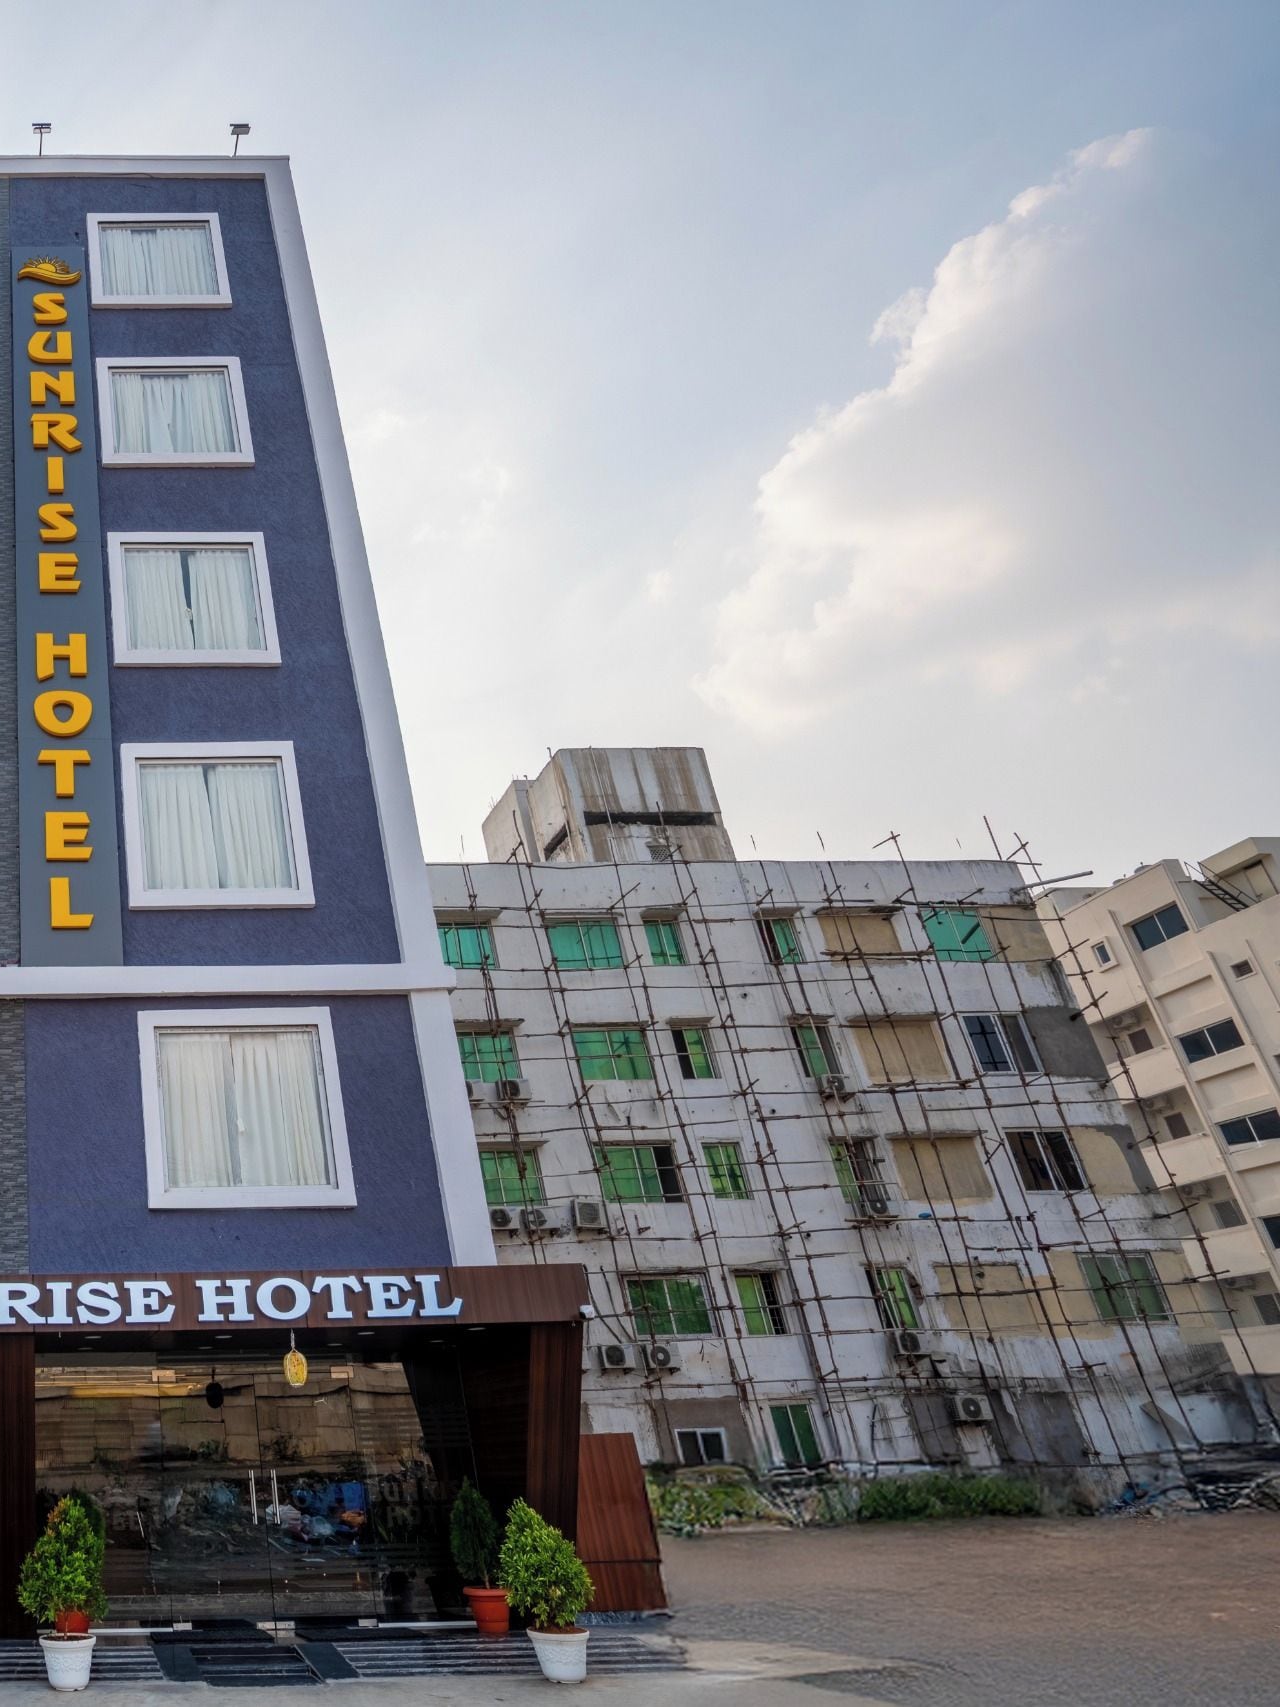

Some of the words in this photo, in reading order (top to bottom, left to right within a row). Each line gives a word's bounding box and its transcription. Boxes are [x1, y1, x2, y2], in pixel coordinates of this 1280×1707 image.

[27, 291, 83, 595] SUNRISE
[33, 632, 95, 930] HOTEL
[195, 1274, 463, 1322] HOTEL
